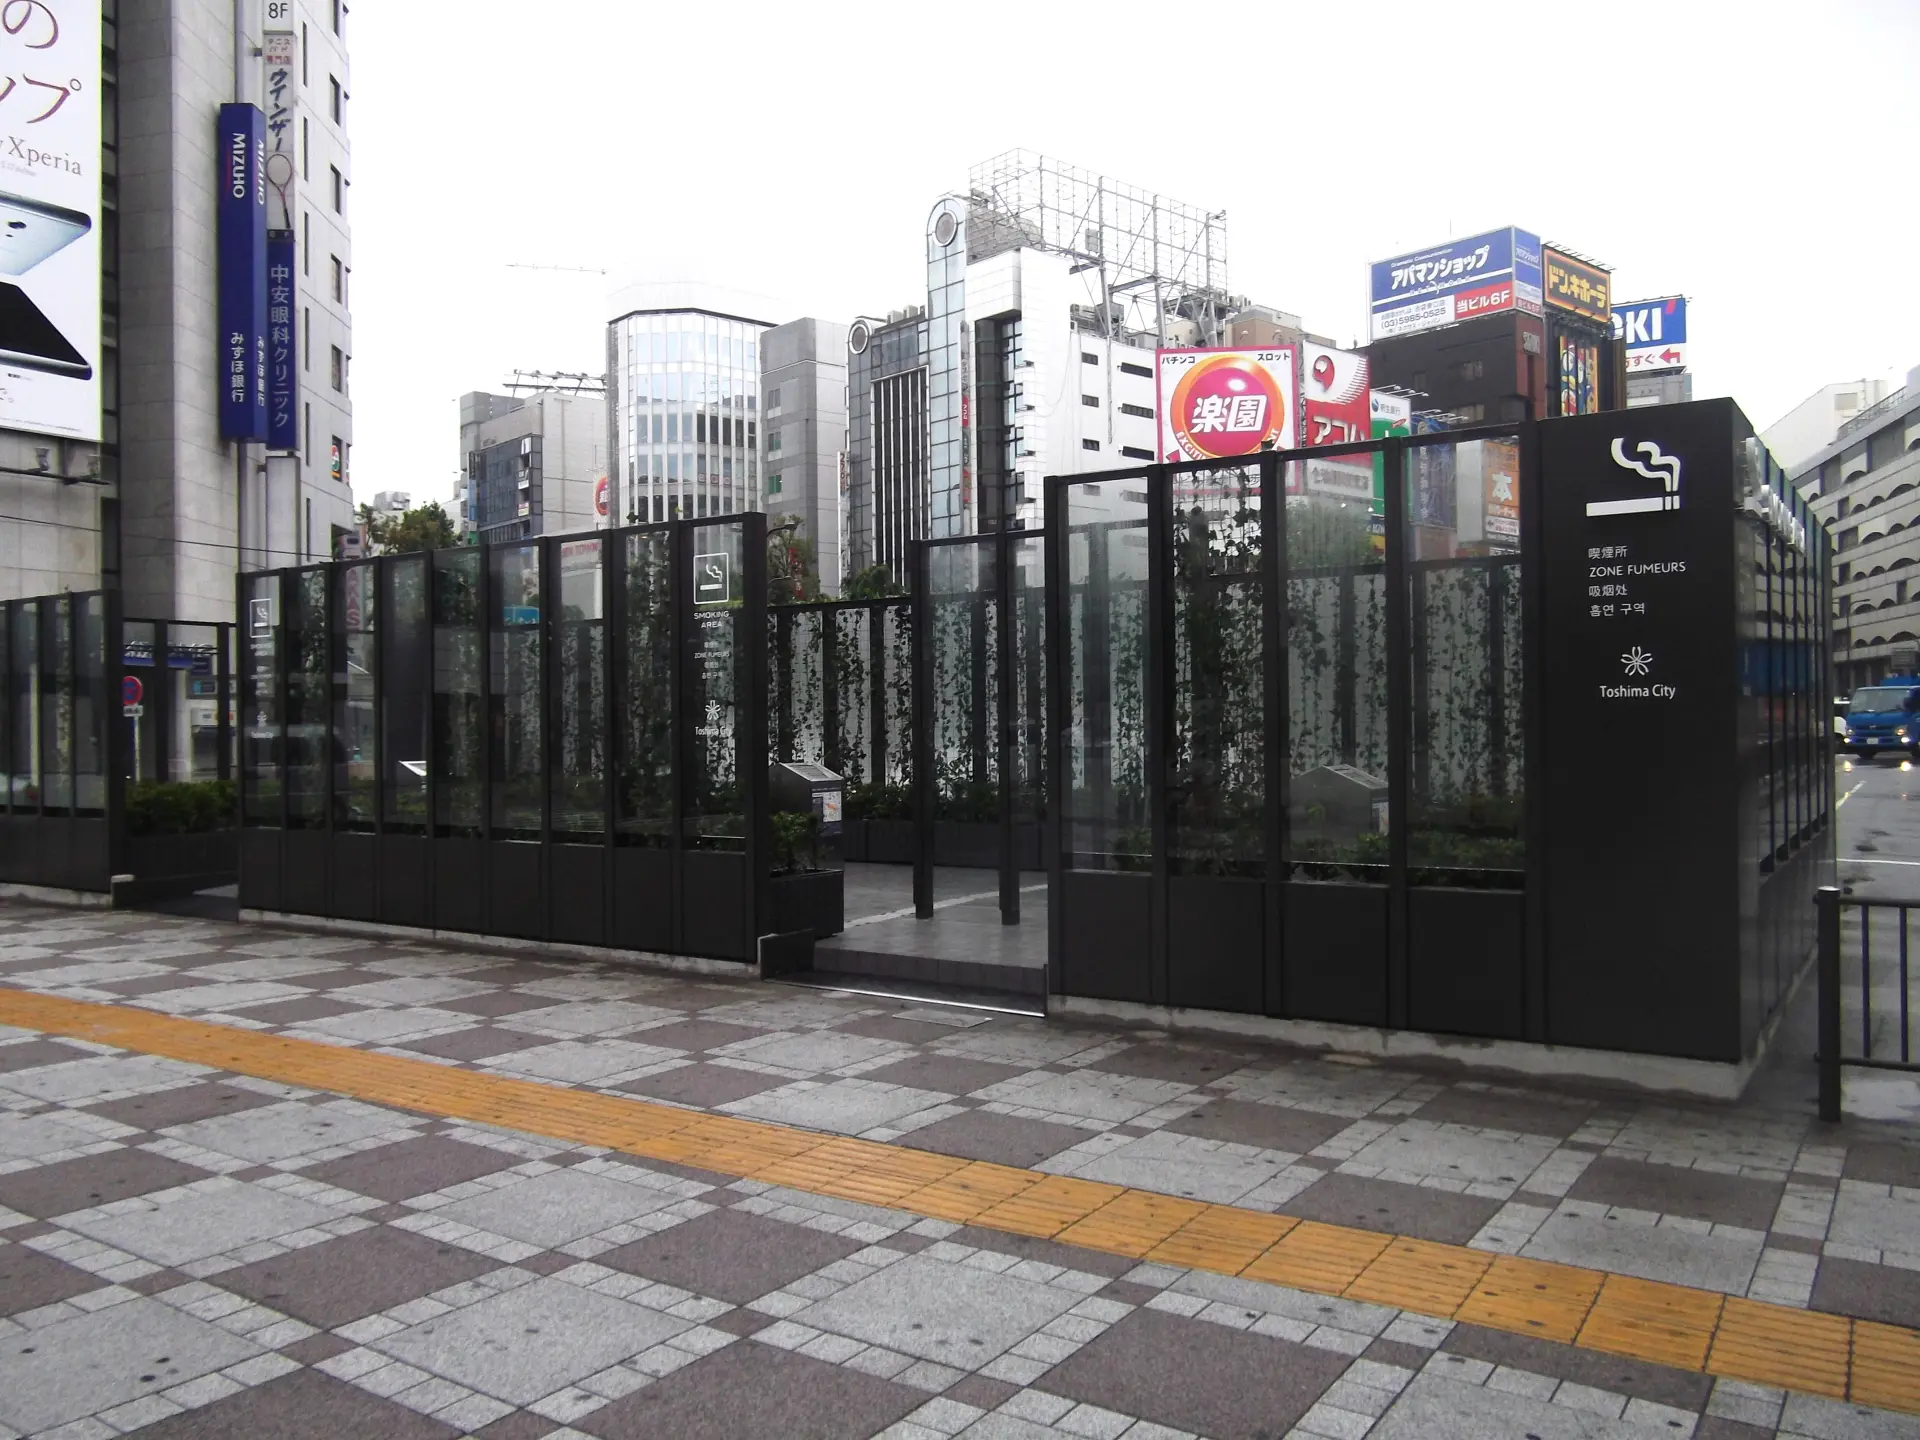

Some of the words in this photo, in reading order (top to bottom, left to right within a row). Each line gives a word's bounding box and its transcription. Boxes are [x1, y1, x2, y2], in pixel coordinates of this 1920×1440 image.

[268, 2, 289, 19] 8F
[2, 0, 59, 49] の
[8, 135, 82, 176] Xperia
[232, 132, 246, 199] MIZUHO
[1391, 244, 1490, 290] アパマンショップ
[1456, 289, 1511, 314] 当ビル6F
[270, 264, 290, 428] 中安眼科クリニック
[1161, 355, 1196, 365] パチンコ
[1257, 352, 1290, 362] スロット
[231, 332, 245, 403] みずほ銀行
[1190, 394, 1268, 434] 楽園
[1588, 545, 1628, 560] 喫煙所
[1589, 565, 1624, 578] ZONE
[1627, 561, 1686, 575] FUMEURS
[1588, 583, 1628, 597] 吸烟处
[693, 610, 730, 620] SMOKING
[1620, 602, 1645, 616] 구역
[701, 620, 723, 629] AREA
[1599, 684, 1650, 698] Toshima
[1652, 683, 1676, 700] City
